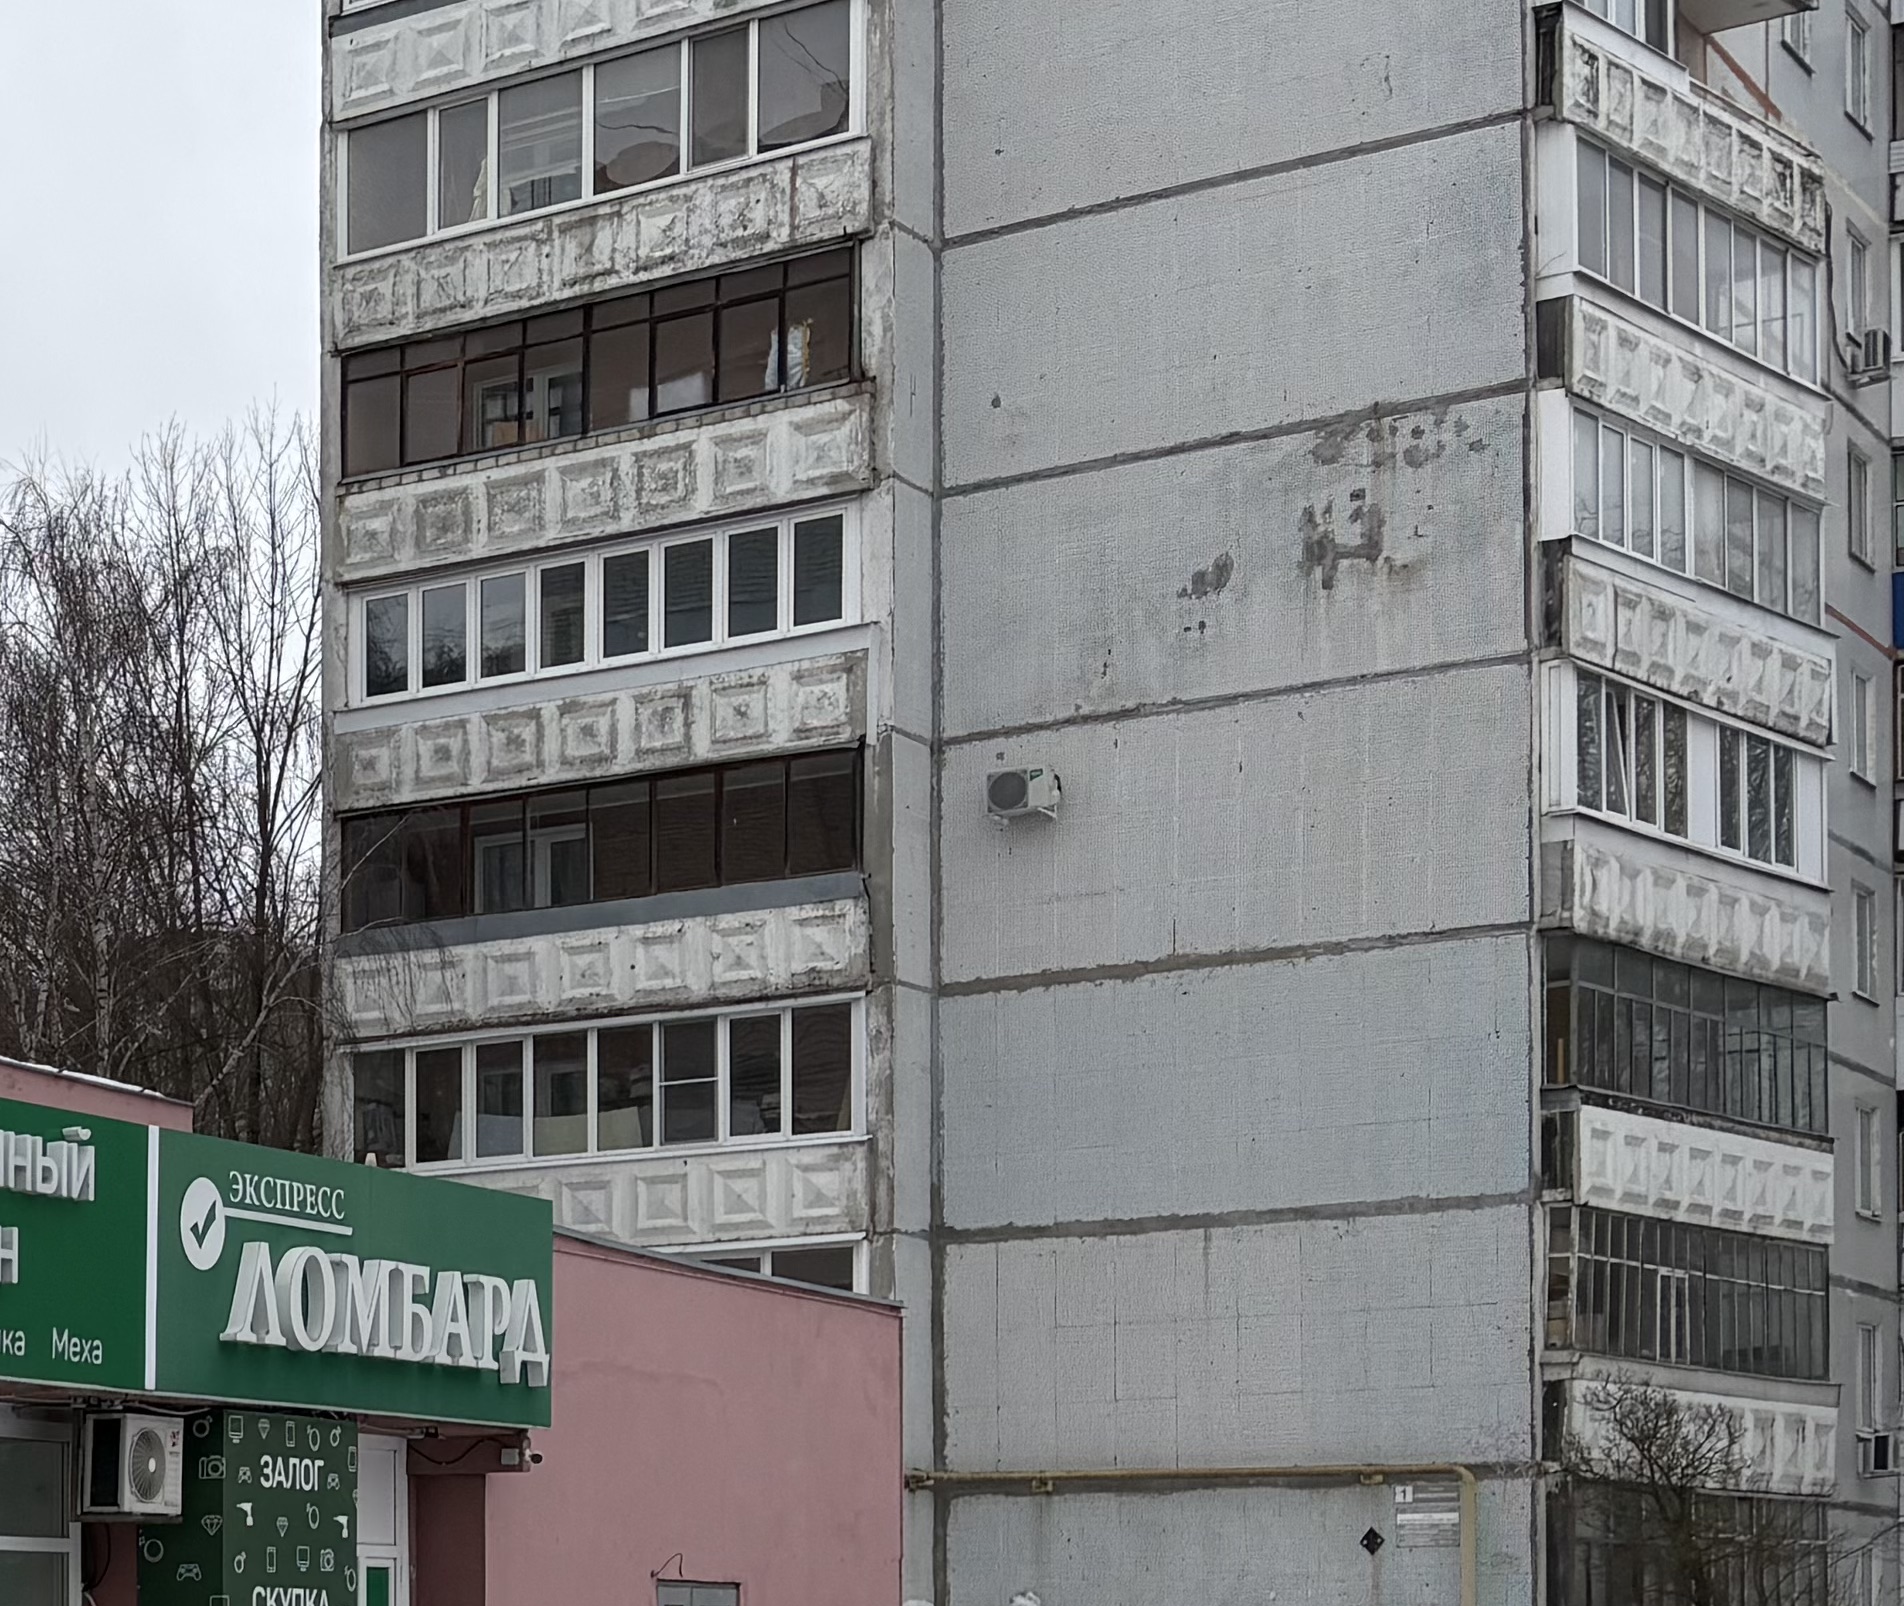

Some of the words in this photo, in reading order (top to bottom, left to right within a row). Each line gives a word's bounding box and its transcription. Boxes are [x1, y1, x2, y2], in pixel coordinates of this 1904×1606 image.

[229, 1171, 345, 1220] ЭКСПРЕСС
[219, 1241, 550, 1388] ЛОМБАРД
[52, 1327, 103, 1365] Меха
[260, 1455, 324, 1491] ЗАЛОГ
